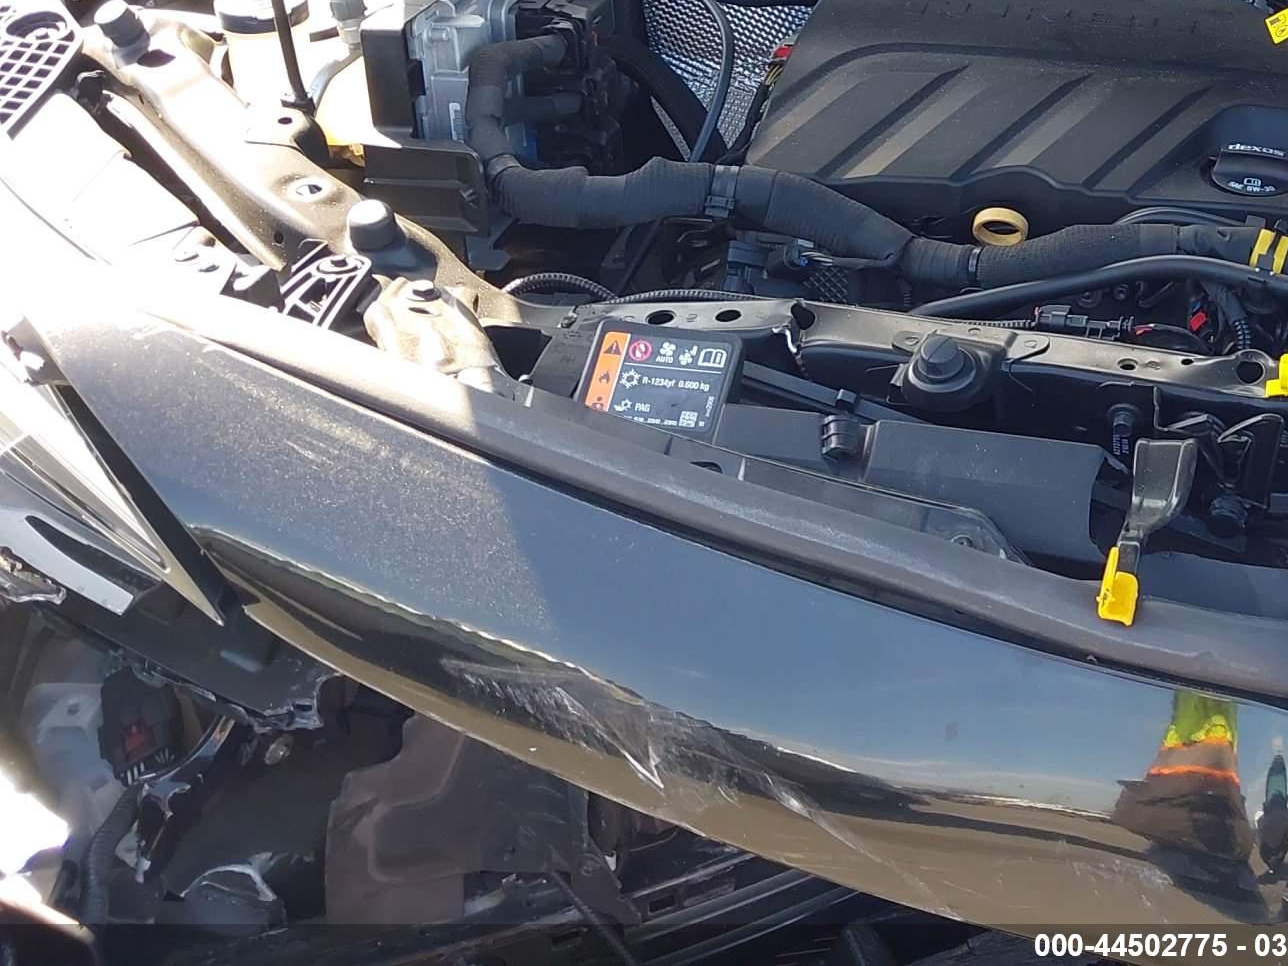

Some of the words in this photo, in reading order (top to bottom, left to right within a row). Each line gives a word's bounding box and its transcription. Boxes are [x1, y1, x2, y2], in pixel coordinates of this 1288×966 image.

[1228, 143, 1285, 156] dexos
[655, 355, 673, 364] AUTO
[642, 376, 675, 388] R-1234yf
[699, 382, 710, 392] kg
[634, 402, 651, 412] PAG
